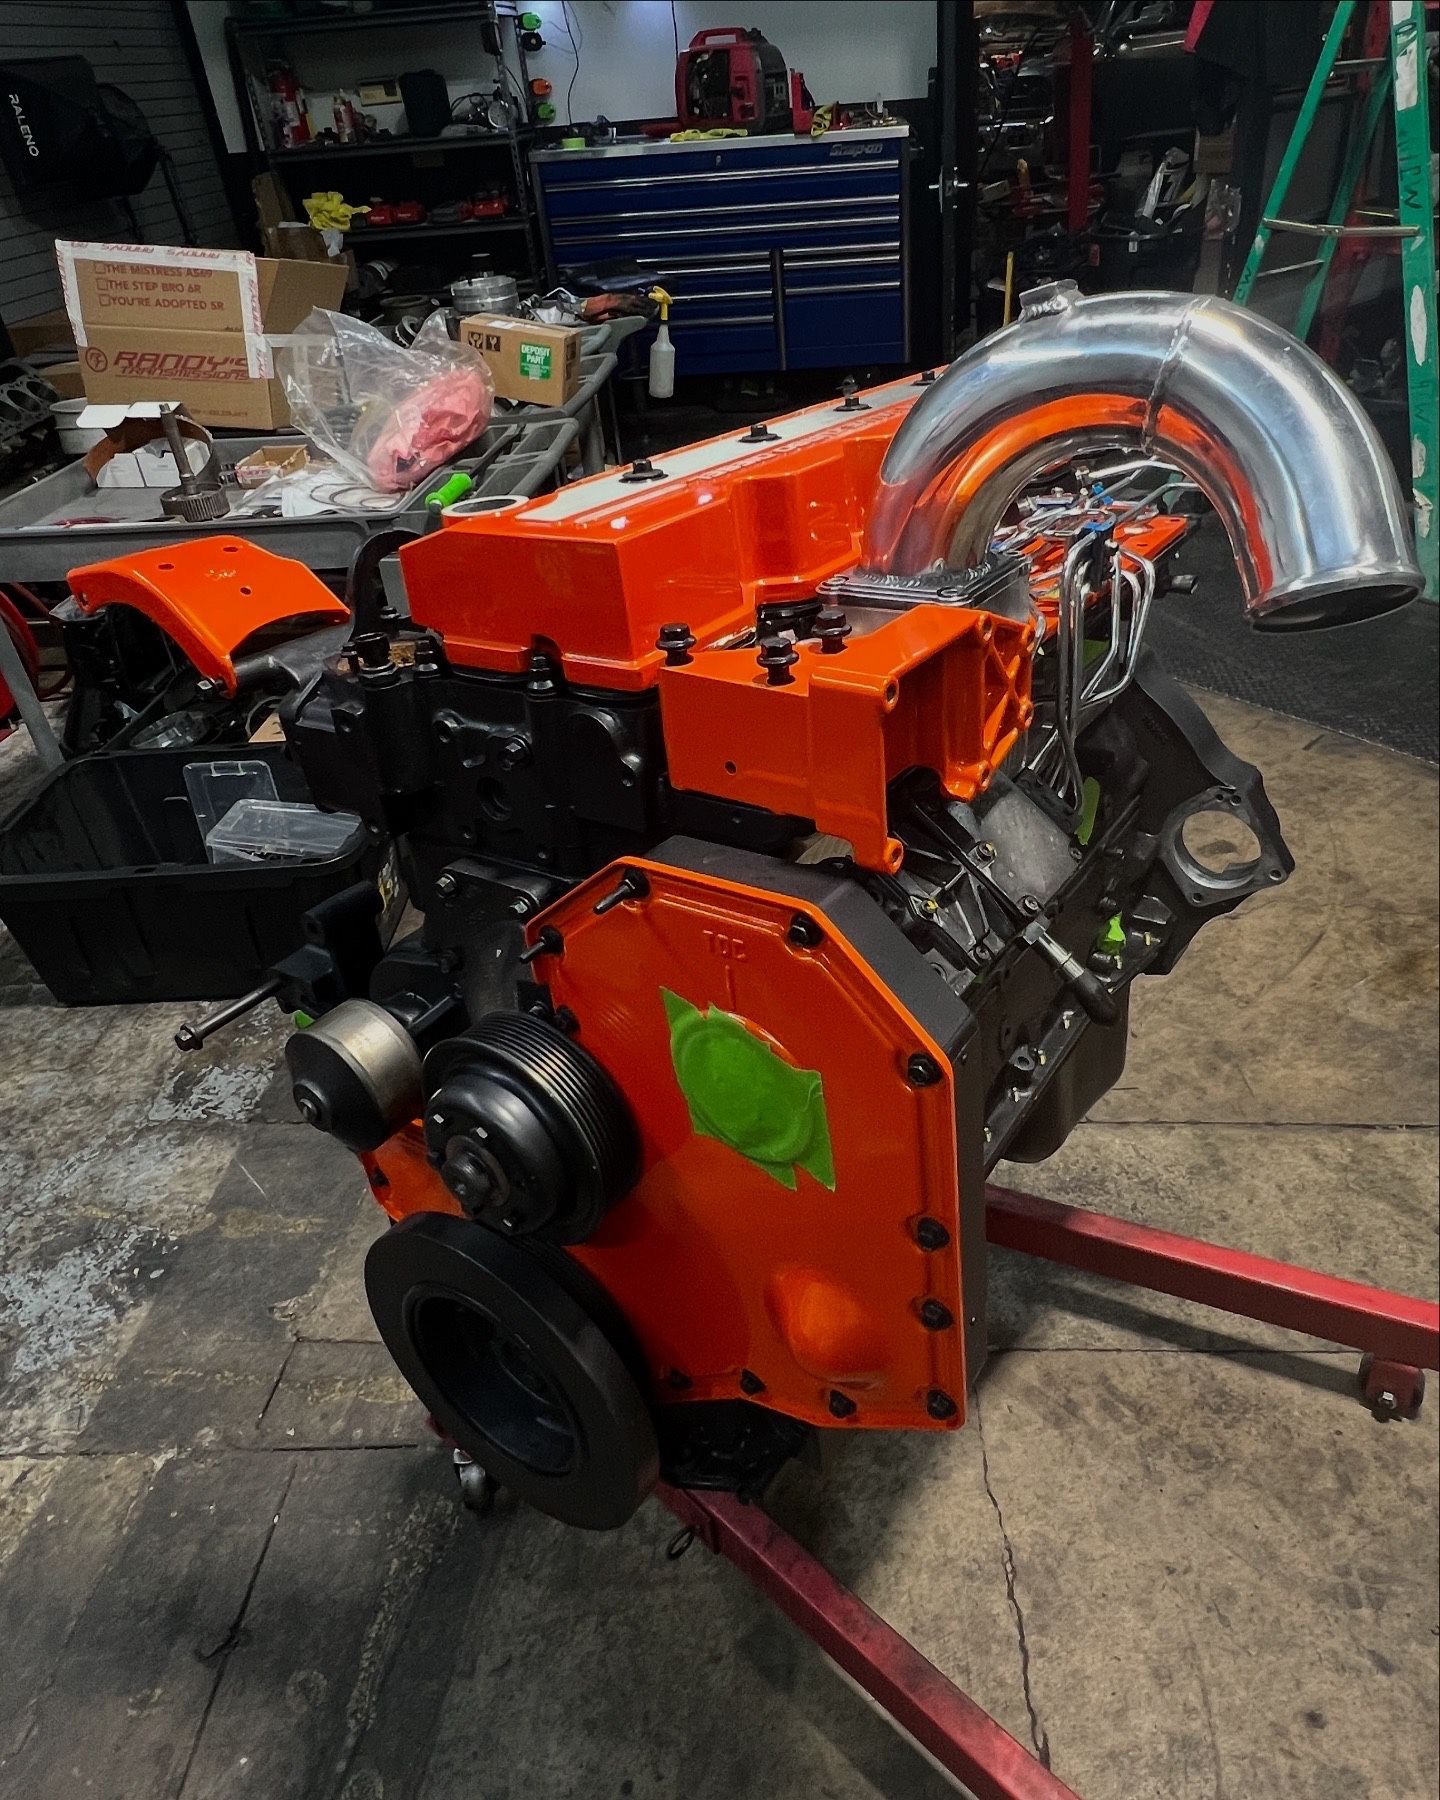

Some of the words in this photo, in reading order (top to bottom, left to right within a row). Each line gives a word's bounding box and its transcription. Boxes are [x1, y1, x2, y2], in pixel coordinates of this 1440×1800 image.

[9, 94, 40, 157] RALENO
[108, 280, 129, 291] THE
[133, 281, 158, 291] STEP
[162, 282, 184, 292] BRO
[111, 295, 150, 306] YOU'RE
[155, 297, 207, 309] ADOPTED
[521, 344, 550, 357] DEPOSIT
[526, 354, 545, 366] PART
[120, 366, 250, 380] TRANSMISSIONS
